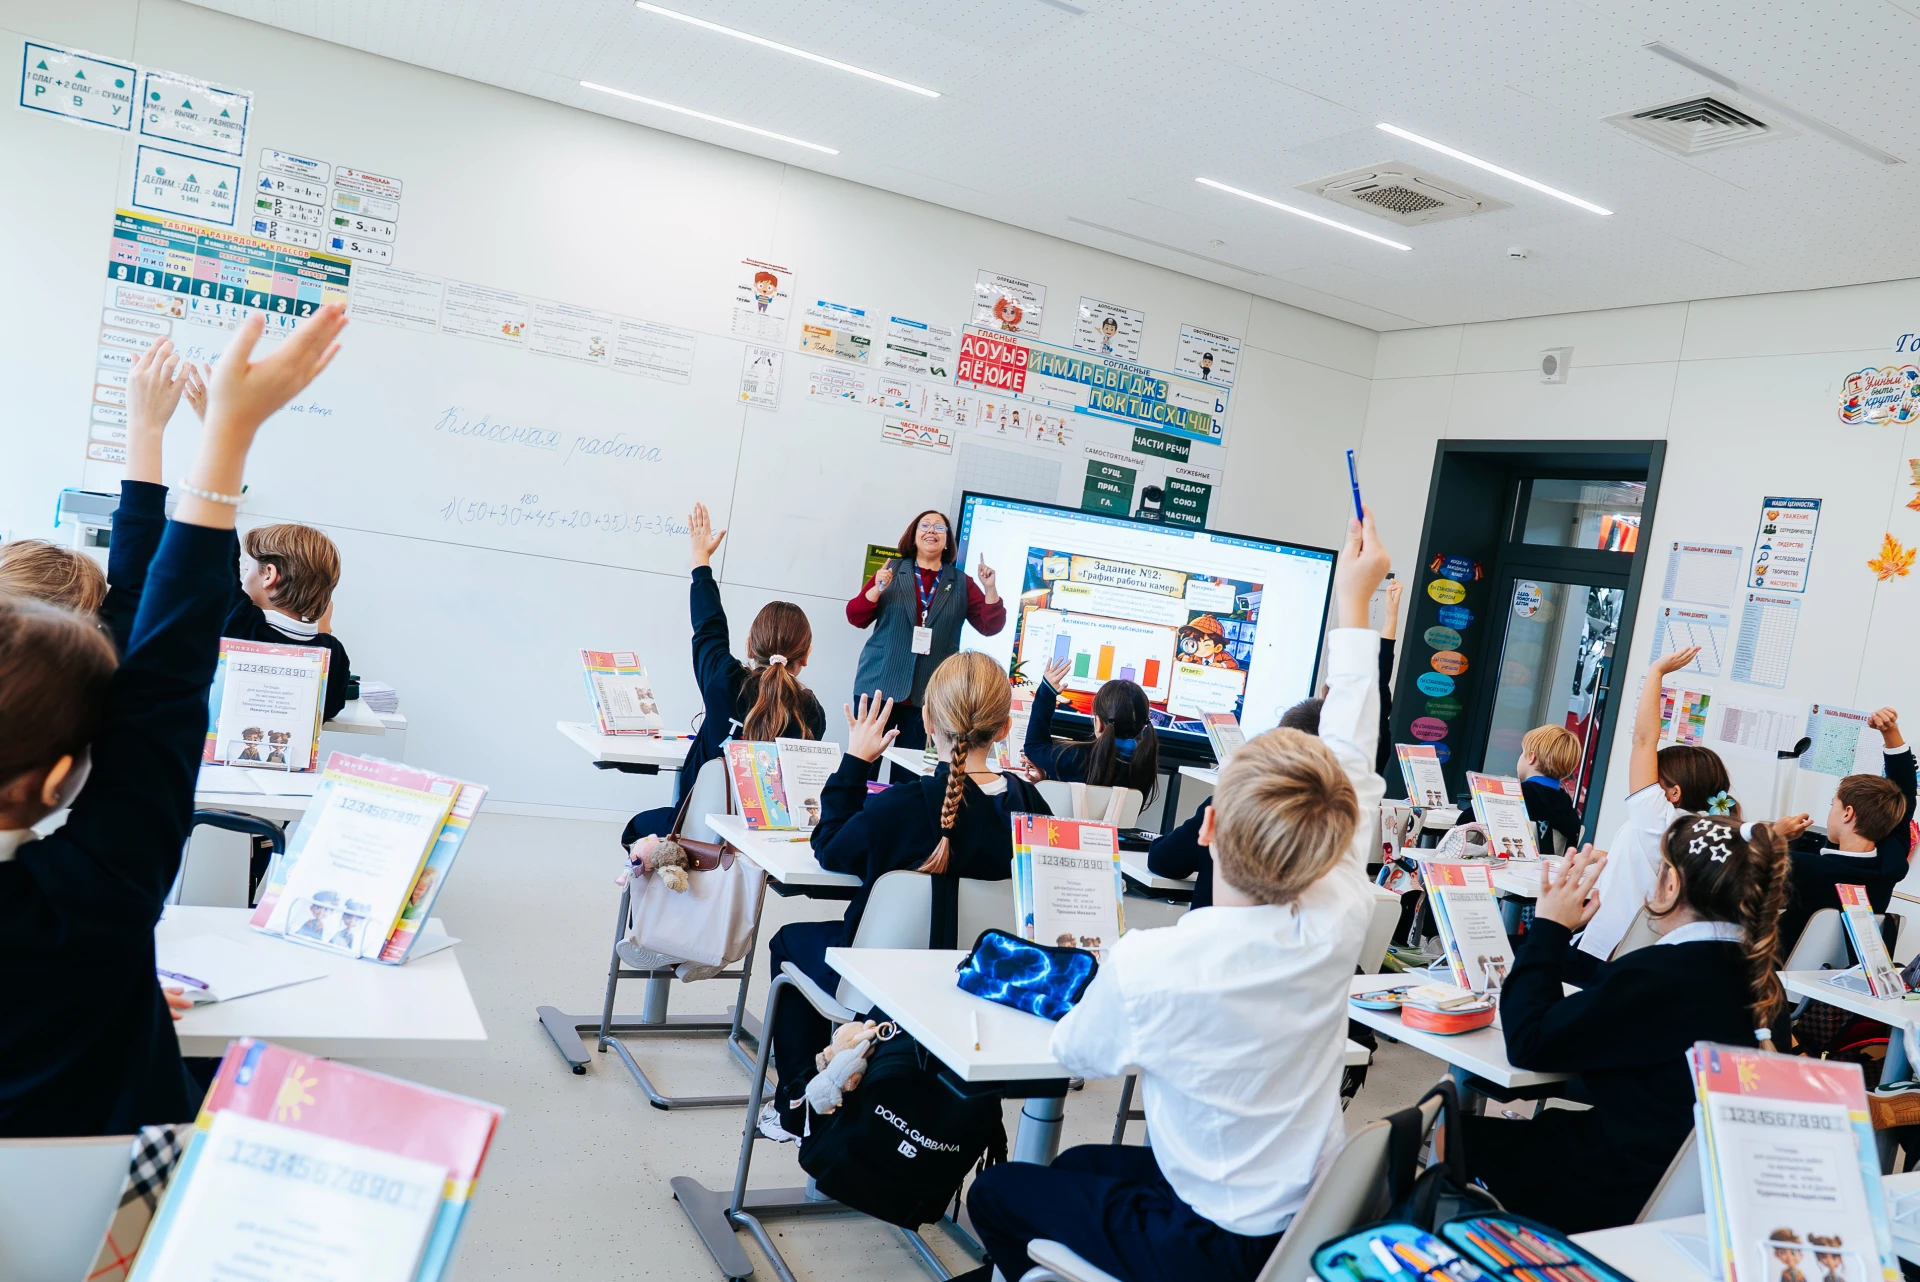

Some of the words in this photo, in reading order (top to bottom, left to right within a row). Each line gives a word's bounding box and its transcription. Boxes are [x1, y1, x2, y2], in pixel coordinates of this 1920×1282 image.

[32, 73, 56, 86] СЛАГ.
[71, 83, 94, 95] СЛАГ.
[102, 90, 130, 102] СУММА
[174, 109, 200, 122] ВЫЧИТ.
[208, 118, 246, 131] РАЗНОСТЬ
[288, 156, 318, 168] ПЕРИМЕТР
[361, 174, 390, 186] ПЛОЩАДЬ
[142, 174, 177, 188] ДЕЛИМ.
[181, 182, 202, 194] ДЕЛ.
[212, 188, 230, 200] ЧАС.
[163, 220, 206, 236] ТАБЛИЦА
[210, 231, 258, 248] РАЗРЯДОВ
[270, 244, 310, 258] КЛАССОВ
[118, 252, 186, 272] МИЛЛИОНОВ
[214, 272, 250, 285] ТЫСЯЧ
[996, 276, 1028, 288] ОПРЕДЕЛЕНИЕ
[117, 266, 128, 280] 9
[144, 271, 154, 286] 8
[172, 276, 182, 291] 7
[200, 282, 210, 297] 6
[224, 288, 234, 302] 5
[251, 294, 261, 308] 4
[276, 298, 287, 312] 3
[301, 304, 312, 318] 2
[118, 291, 144, 301] ЗАДАЧИ
[120, 299, 156, 310] ДВИЖЕНИЕ
[1098, 304, 1127, 314] ДОПОЛНЕНИЕ
[114, 316, 161, 330] ЛИДЕРСТВО
[102, 333, 137, 344] РУССКИЙ
[1193, 329, 1229, 342] ОБСТОЯТЕЛЬСТВО
[104, 354, 132, 364] МАТЕМ
[978, 330, 1018, 344] ГЛАСНЫЕ
[1104, 360, 1151, 376] СОГЛАСНЫЕ
[1864, 376, 1902, 391] Умным
[885, 388, 902, 396] -ИТЬ
[1871, 387, 1894, 396] быть
[1215, 398, 1224, 414] Ь
[1864, 390, 1906, 409] круто!
[900, 422, 918, 430] ЧАСТИ
[920, 426, 939, 434] СЛОВА
[1212, 419, 1222, 434] Ъ
[434, 405, 560, 448] Классная
[563, 432, 662, 466] работа
[1134, 436, 1164, 450] ЧАСТИ
[1166, 443, 1190, 456] РЕЧИ
[1084, 446, 1144, 466] САМОСТОЯТЕЛЬНЫЕ
[1102, 466, 1122, 478] СУЩ.
[1176, 467, 1210, 480] СЛУЖЕБНЫЕ
[1098, 482, 1121, 493] ПРИЛ.
[1171, 482, 1206, 494] ПРЕДЛОГ
[520, 493, 538, 505] 180
[1100, 498, 1112, 507] ГЛ.
[1173, 497, 1196, 508] СОЮЗ
[1165, 510, 1201, 524] ЧАСТИЦА
[1094, 560, 1136, 576] Задание
[1139, 568, 1162, 580] №2:
[1078, 570, 1114, 582] «График
[1116, 576, 1147, 587] работы
[1149, 582, 1179, 593] камер»
[1191, 584, 1216, 592] Материал:
[1770, 580, 1798, 588] МАСТЕРСТВО
[1062, 585, 1090, 594] Задание:
[1062, 618, 1097, 627] Активность
[1098, 622, 1117, 630] камер
[1118, 625, 1154, 634] наблюдения
[238, 664, 306, 678] 1234567890
[1180, 666, 1201, 676] Ответ:
[1839, 712, 1860, 721] ПОВЕДЕНИЯ
[785, 744, 832, 754] 1234567890
[340, 798, 421, 826] 1234567890
[1042, 855, 1102, 870] 1234567890
[1730, 1107, 1832, 1130] 1234567890
[874, 1104, 908, 1132] DOLCE
[910, 1130, 960, 1152] GABBANA
[897, 1140, 918, 1158] DG
